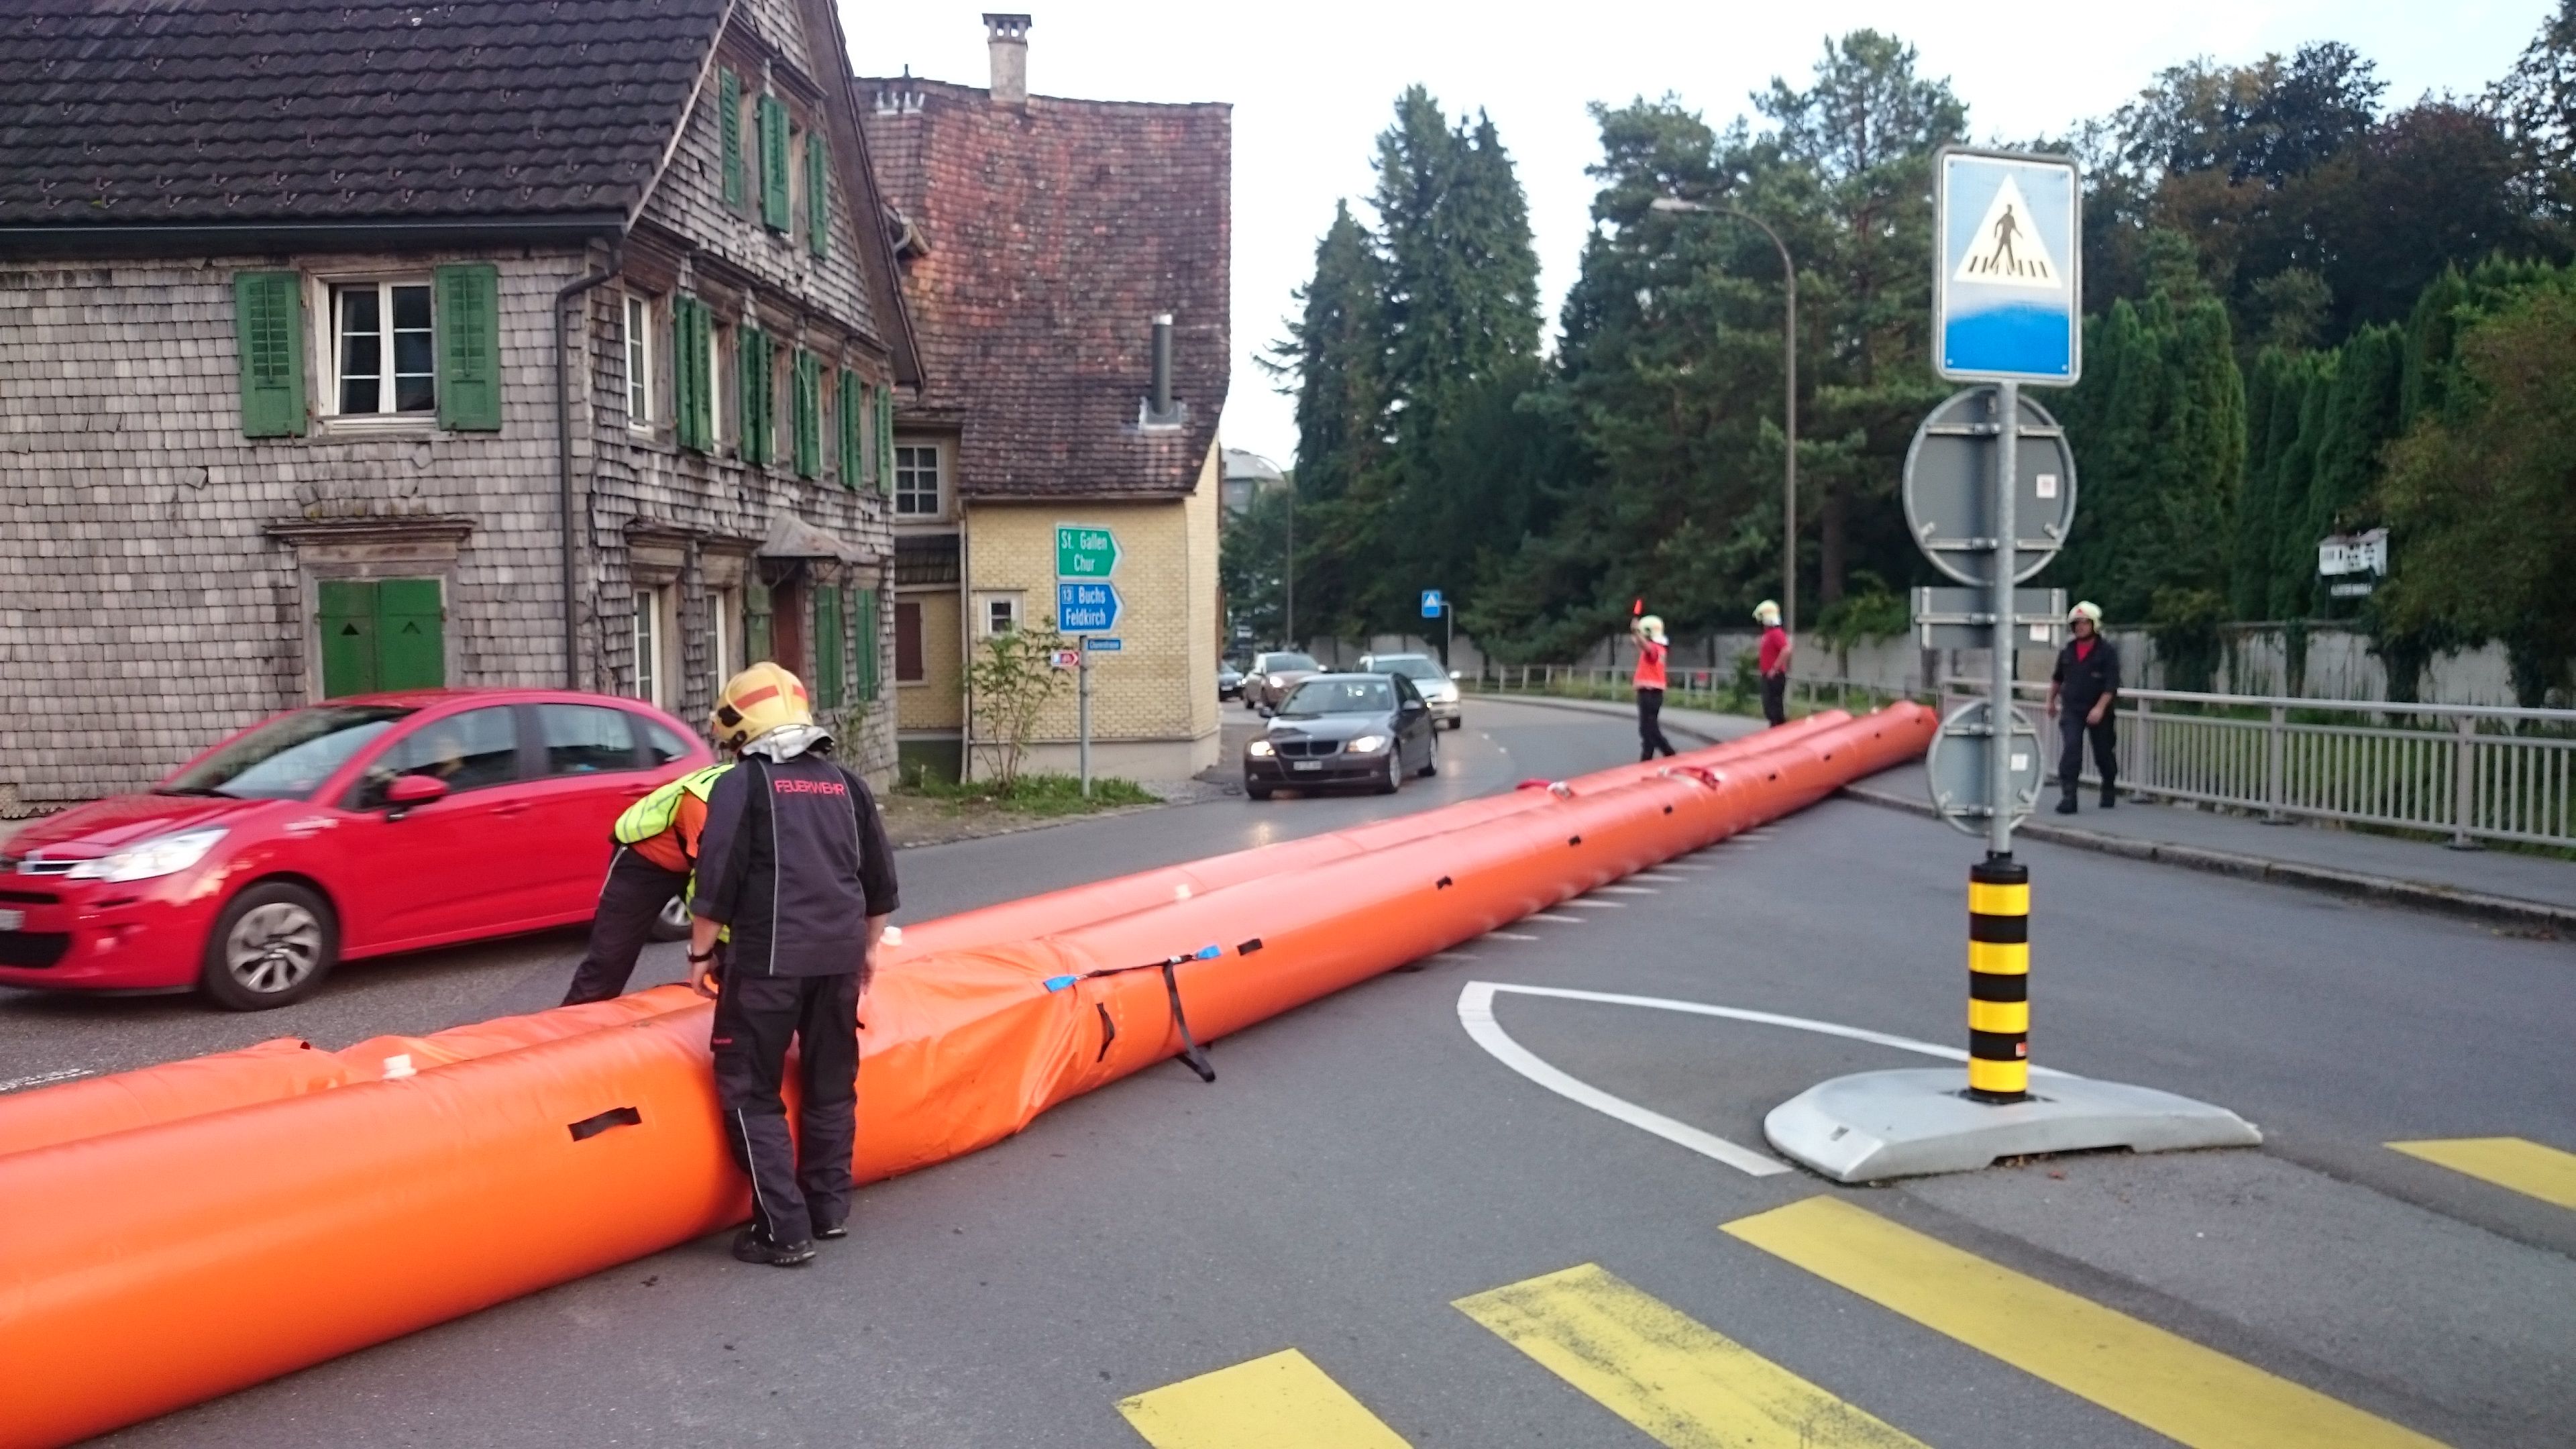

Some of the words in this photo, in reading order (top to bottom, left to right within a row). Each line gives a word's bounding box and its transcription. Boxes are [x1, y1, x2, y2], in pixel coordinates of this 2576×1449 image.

[1061, 530, 1074, 549] St.
[1080, 531, 1108, 550] Gallen
[1074, 553, 1095, 572] Chur
[1063, 588, 1072, 602] 13
[1079, 586, 1106, 604] Buchs
[1066, 607, 1106, 626] Feldkirch
[774, 780, 845, 796] FEUERWEHR
